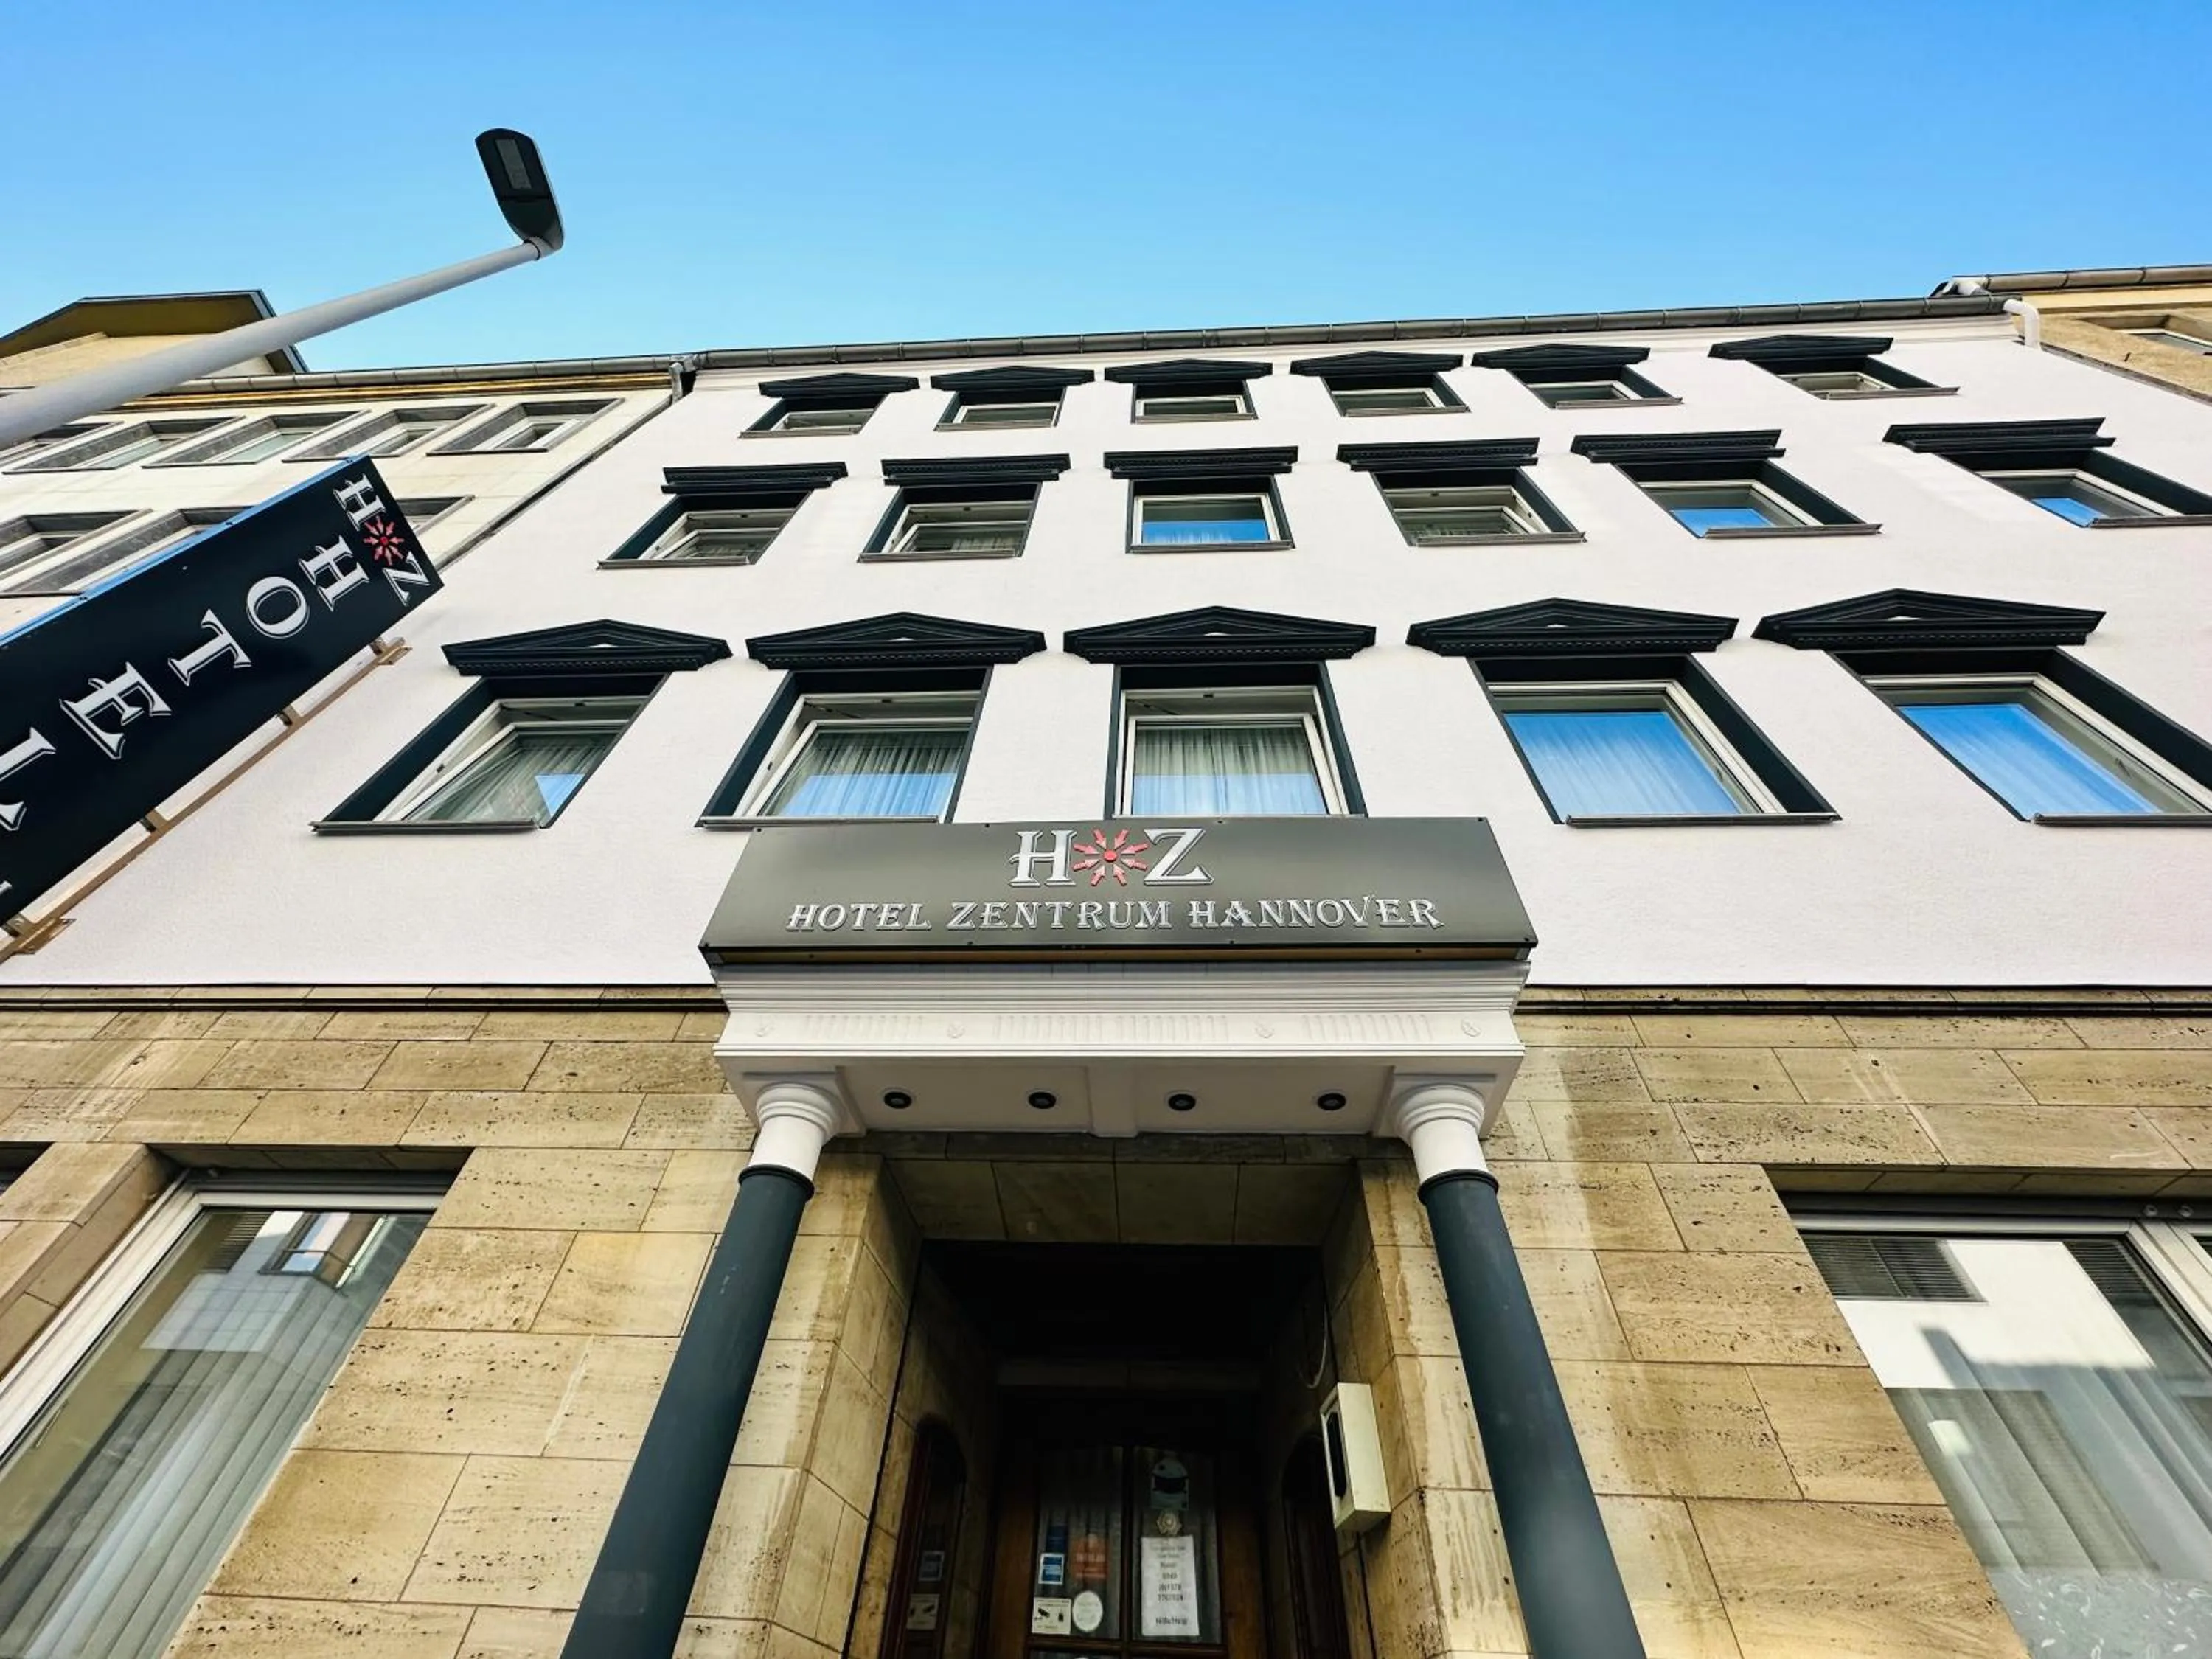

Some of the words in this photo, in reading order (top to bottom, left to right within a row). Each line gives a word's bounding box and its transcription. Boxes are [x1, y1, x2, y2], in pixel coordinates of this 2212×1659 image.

[785, 902, 932, 931] HOTEL
[946, 900, 1173, 931] ZENTRUM
[1187, 894, 1445, 929] HANNOVER
